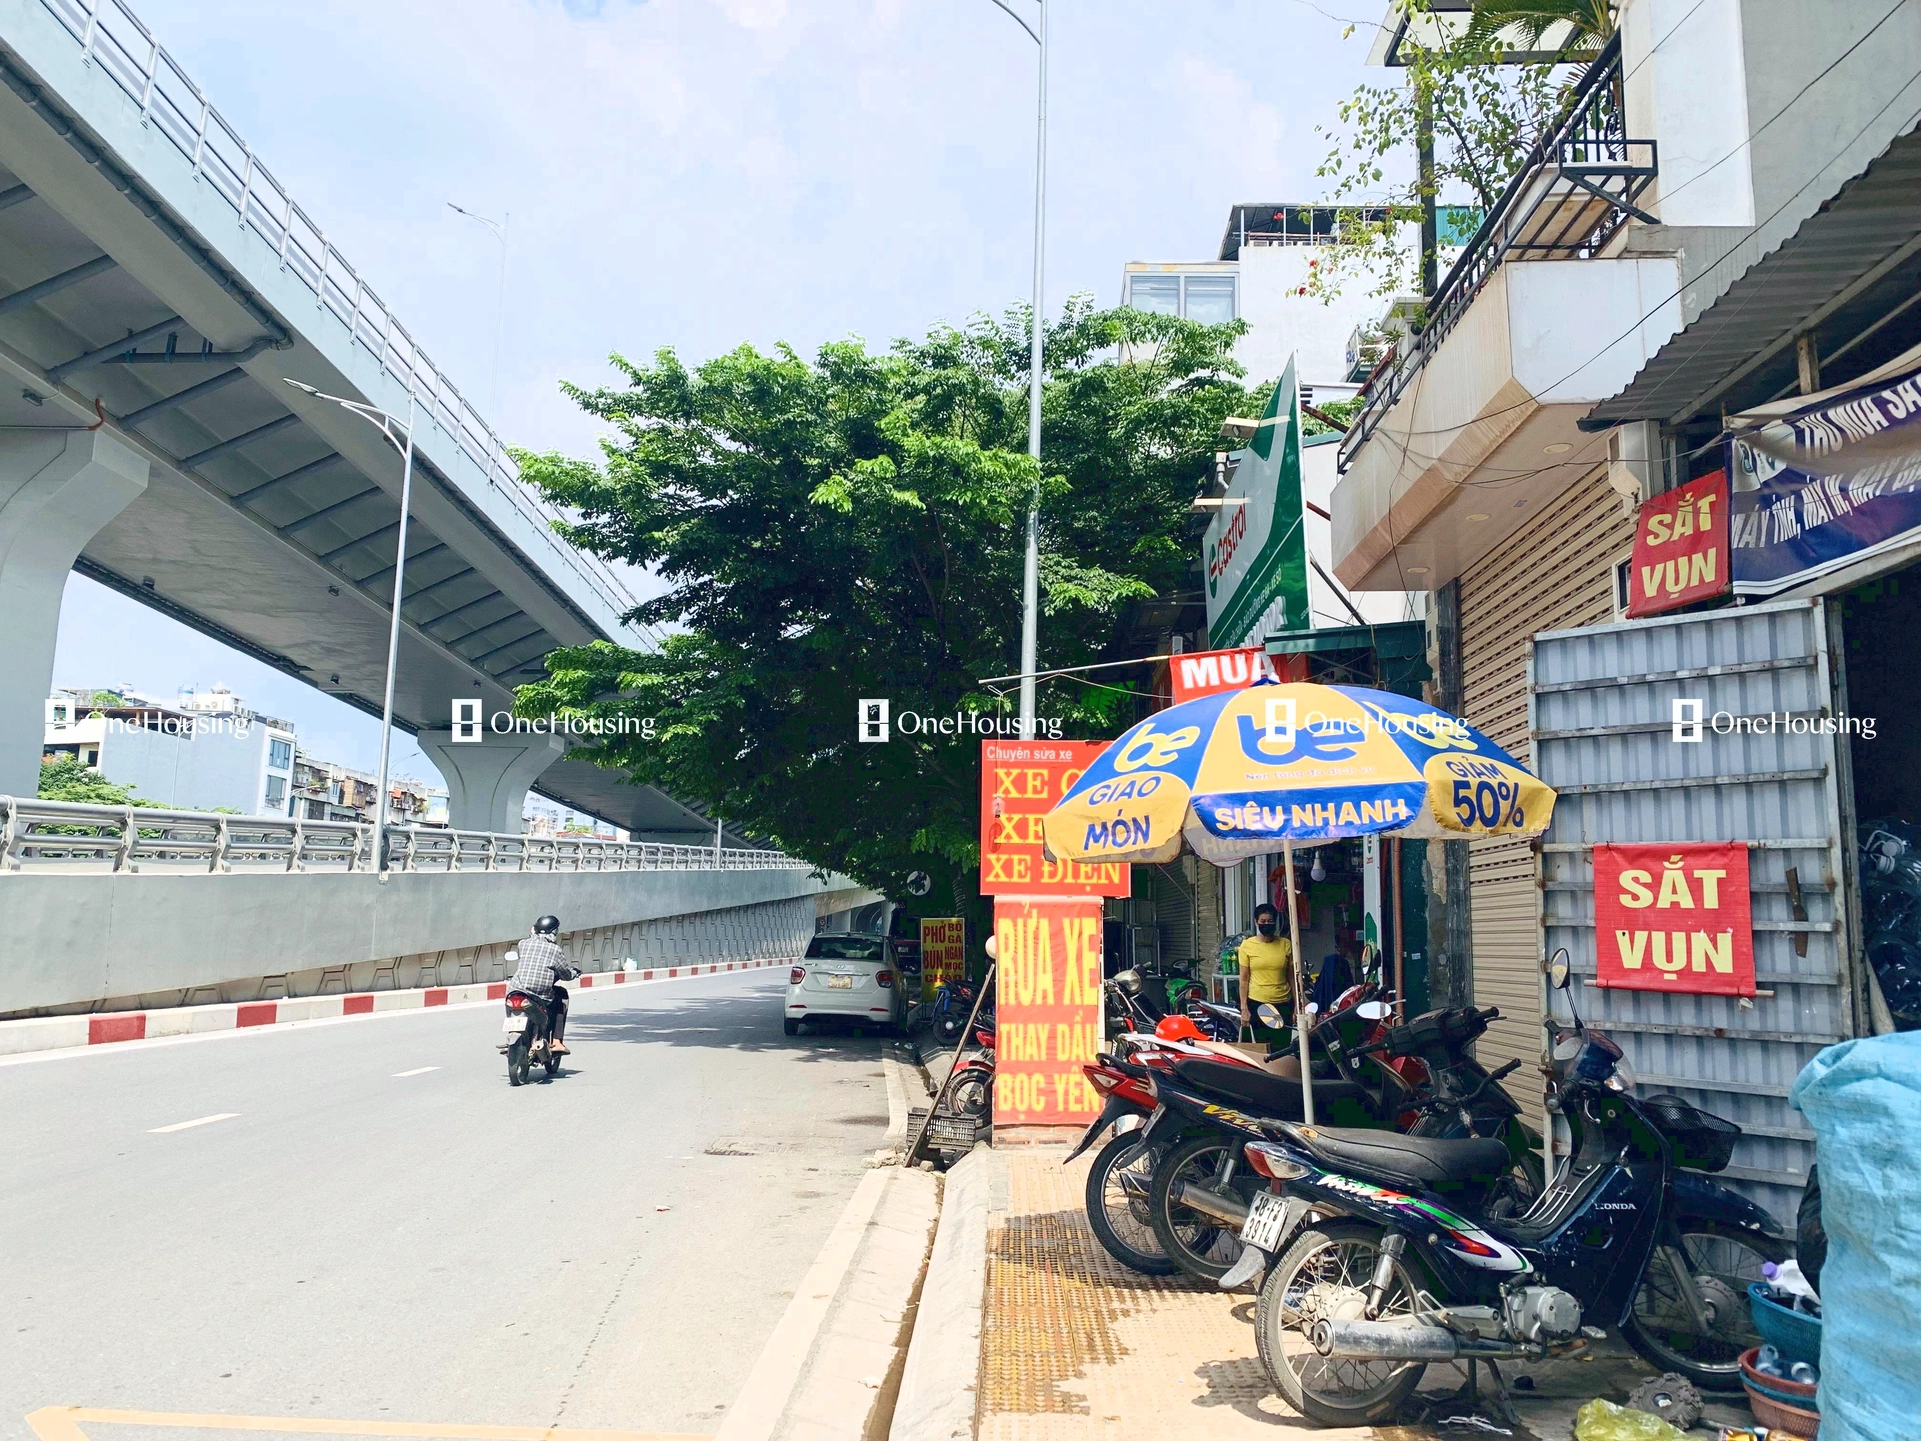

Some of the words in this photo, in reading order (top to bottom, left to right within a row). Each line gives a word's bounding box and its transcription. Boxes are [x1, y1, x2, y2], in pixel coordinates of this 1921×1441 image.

[1795, 411, 1843, 462] THU
[1827, 397, 1890, 443] MUA
[1881, 373, 1921, 419] SA
[1216, 489, 1247, 577] Castrol
[1646, 491, 1717, 546] SẮT
[1641, 547, 1717, 599] VỤN
[1180, 650, 1281, 689] MUA
[986, 746, 1030, 762] Chuyên
[1033, 746, 1056, 760] sửa
[1059, 750, 1073, 760] xe
[1113, 723, 1201, 772] be
[1445, 755, 1509, 780] GIẢM
[993, 768, 1048, 799] XE
[1088, 776, 1163, 806] GIAO
[1452, 779, 1525, 828] 50%
[993, 813, 1043, 844] XE
[1083, 809, 1151, 851] MÓN
[1215, 801, 1284, 831] SIÊU
[1292, 798, 1407, 828] NHANH
[985, 854, 1031, 883] XE
[1618, 854, 1727, 909] SẮT
[923, 921, 947, 944] PHỞ
[944, 946, 964, 960] NGAN
[997, 901, 1054, 1006] RỬA
[1063, 917, 1098, 1006] XE
[923, 945, 943, 970] BÚN
[1614, 929, 1734, 980] VỤN
[999, 1022, 1049, 1061] THAY
[1056, 1010, 1099, 1062] DẦU
[997, 1072, 1046, 1121] BỌC
[1053, 1066, 1100, 1112] YÊN
